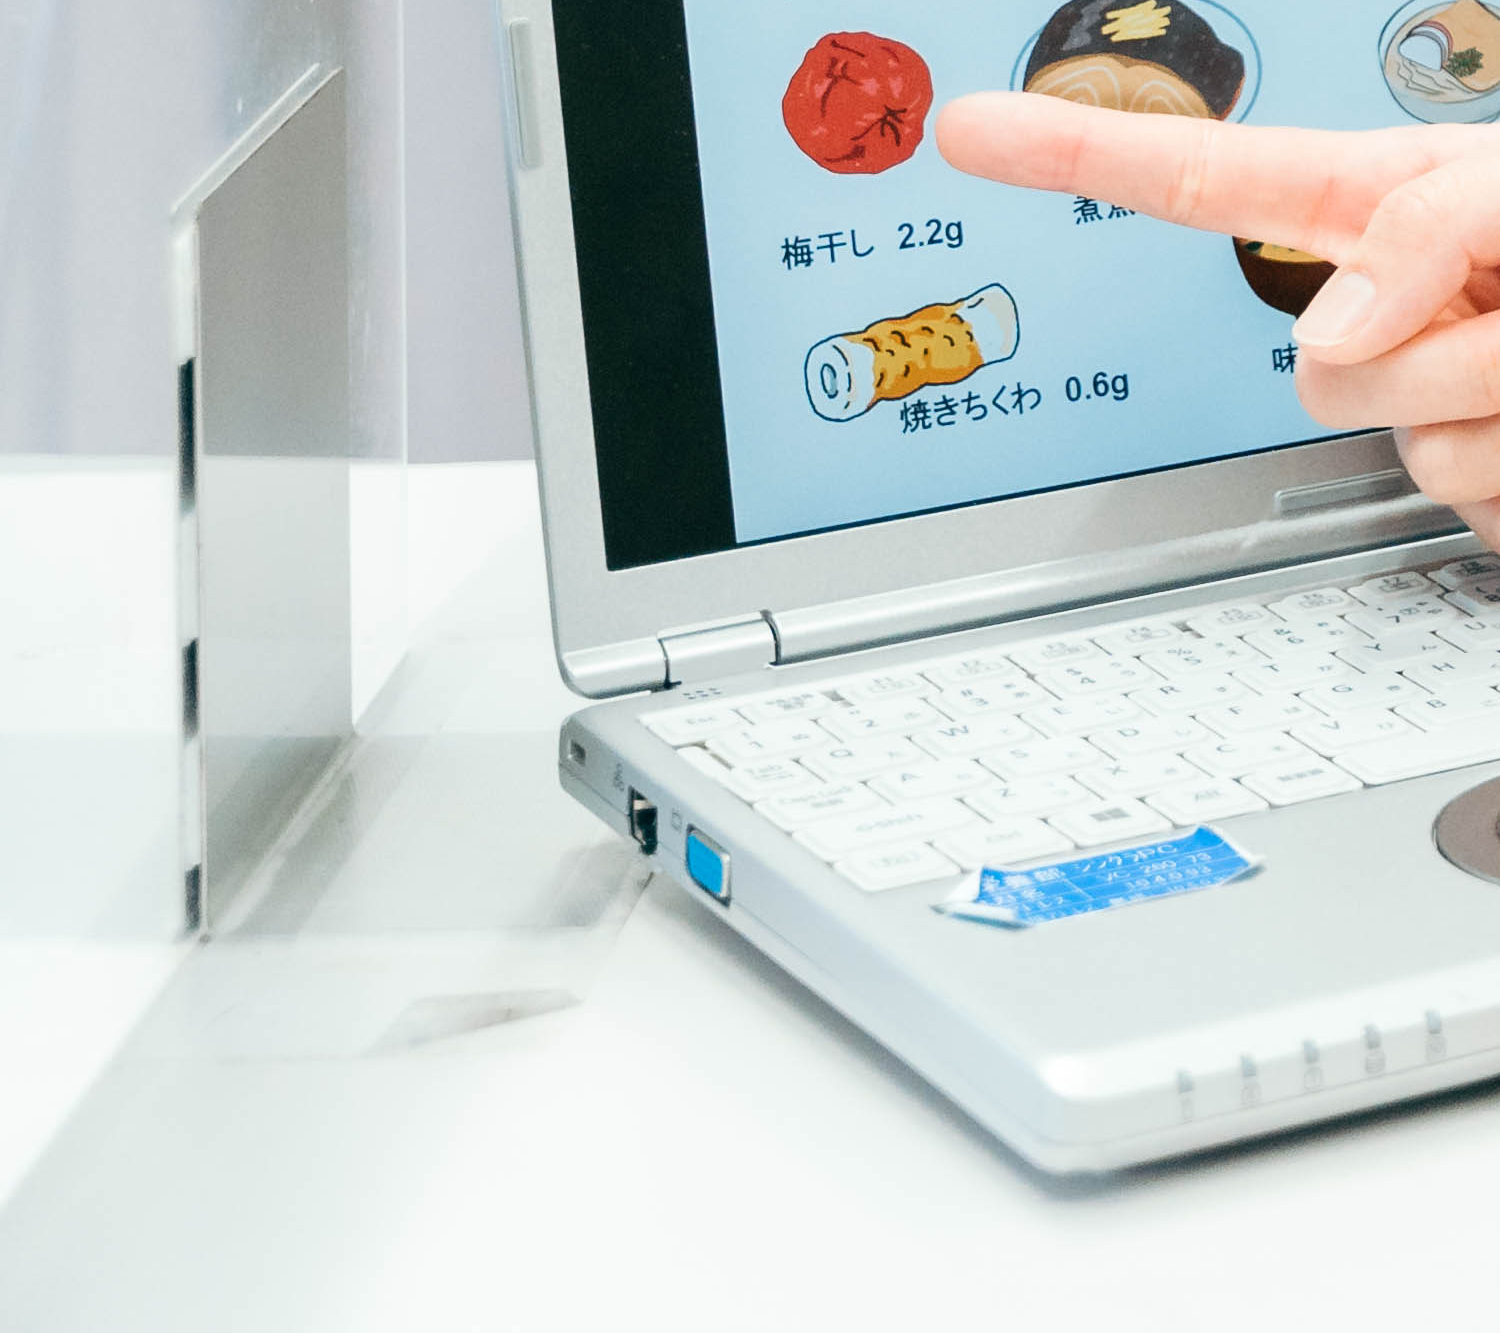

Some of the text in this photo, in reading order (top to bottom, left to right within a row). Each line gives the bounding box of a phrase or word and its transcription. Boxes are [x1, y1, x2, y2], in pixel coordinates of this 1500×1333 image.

[780, 217, 964, 271] 梅干し 2.2g
[900, 371, 1129, 434] 焼きちくわ 0.6g
